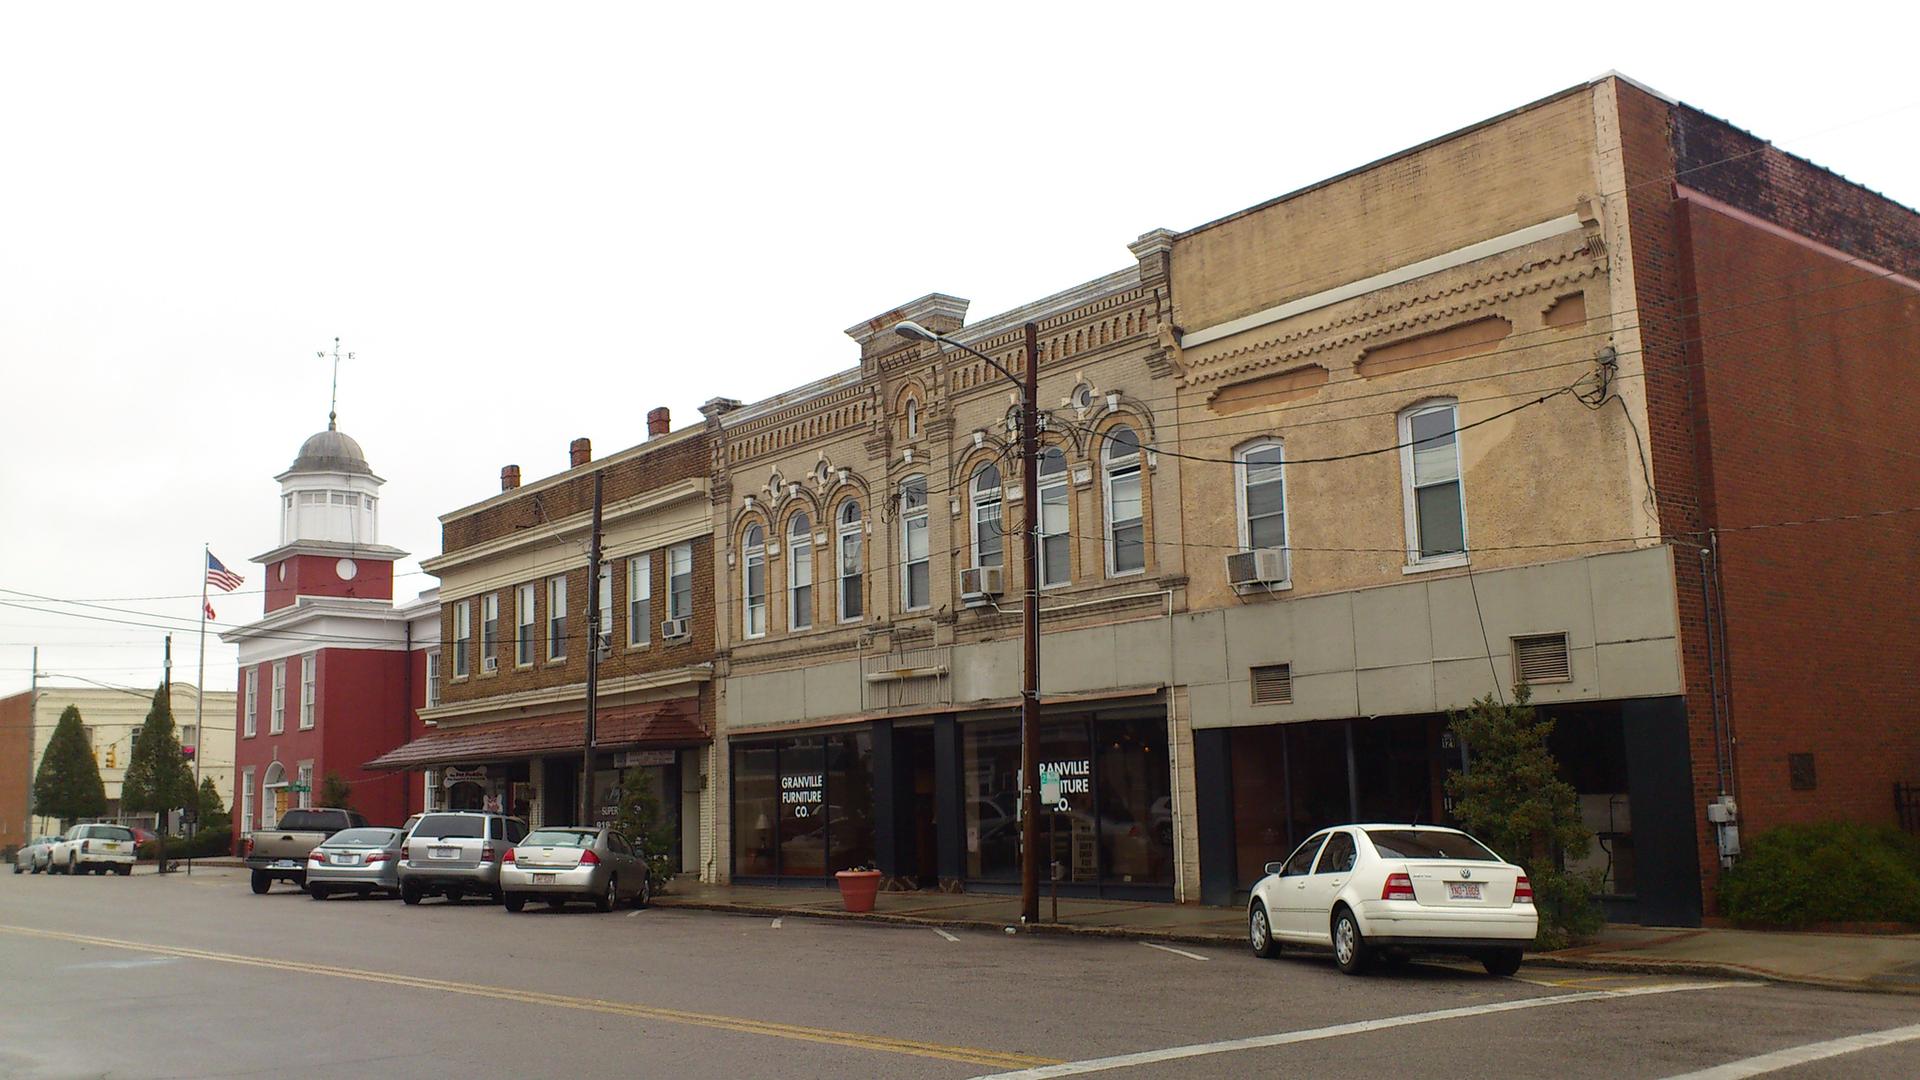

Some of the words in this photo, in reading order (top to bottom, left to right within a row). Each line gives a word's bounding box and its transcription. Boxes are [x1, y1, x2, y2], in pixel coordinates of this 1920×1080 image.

[1039, 760, 1090, 776] RANVILLE
[781, 775, 823, 789] GRANVILLE
[1054, 779, 1089, 793] ITURE
[782, 791, 821, 803] FURNITURE
[795, 805, 810, 818] CO.
